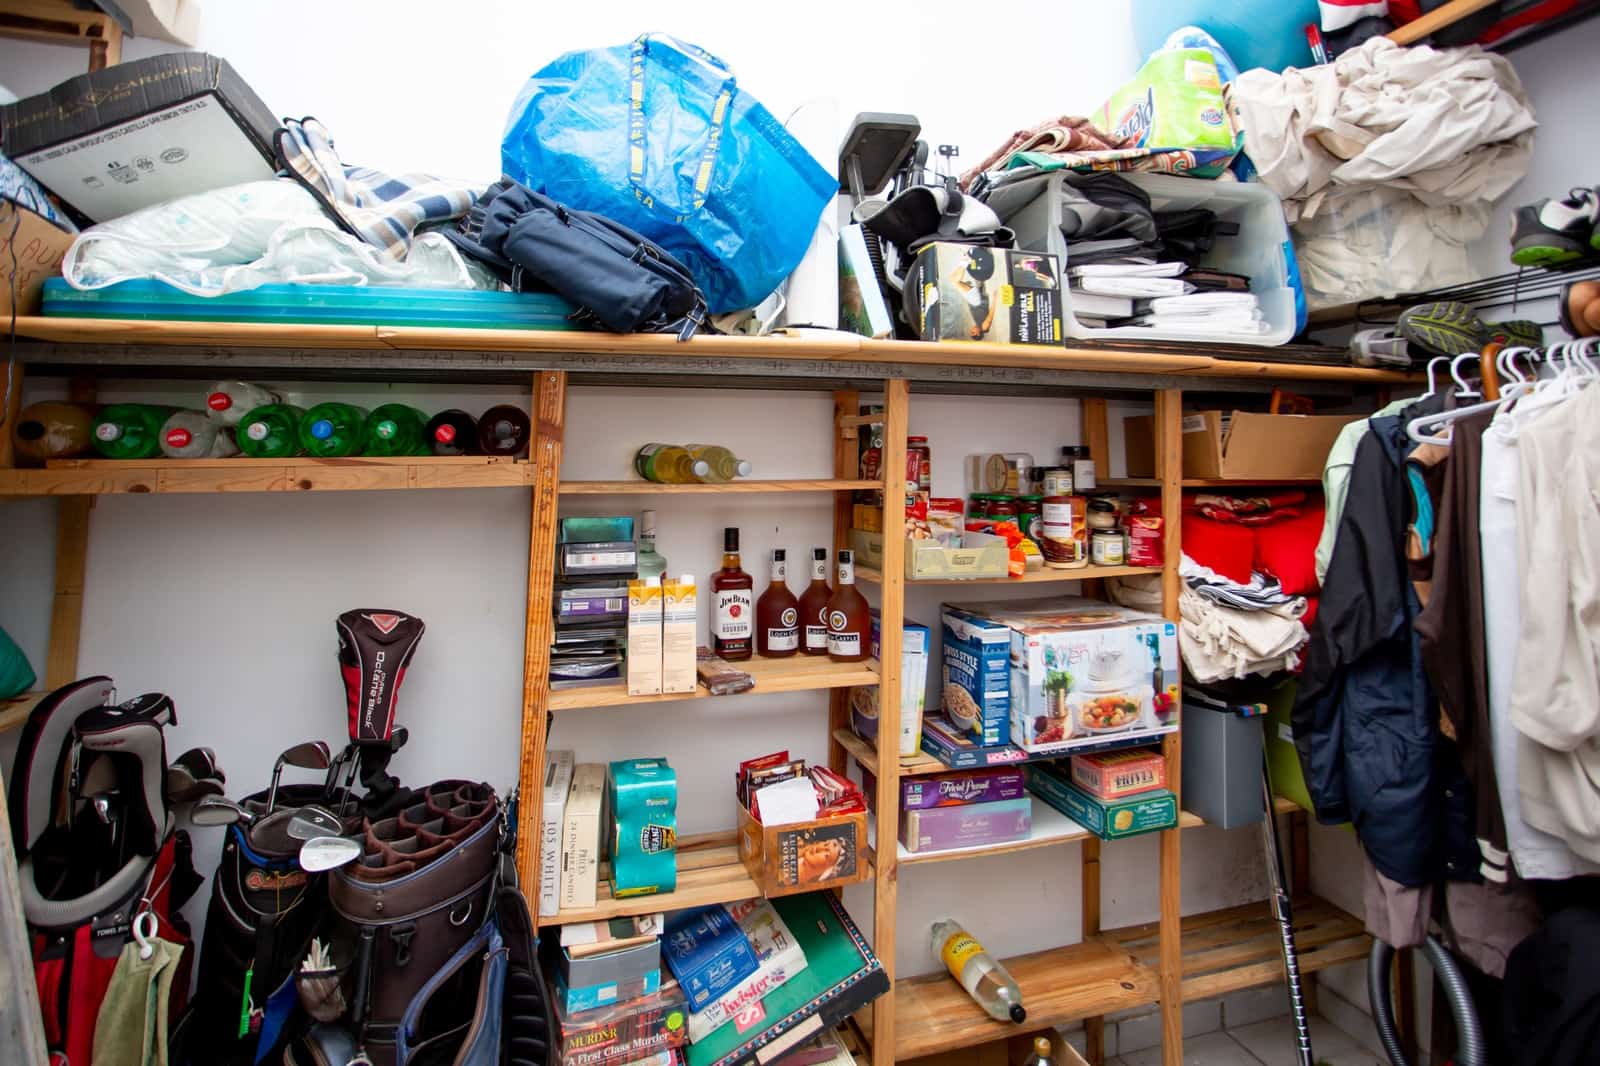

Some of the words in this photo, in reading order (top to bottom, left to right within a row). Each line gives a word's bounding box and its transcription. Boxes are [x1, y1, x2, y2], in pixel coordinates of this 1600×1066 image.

[720, 597, 732, 608] JIM
[369, 650, 386, 697] Octane
[364, 698, 377, 729] Black
[547, 820, 557, 844] 105
[568, 833, 577, 866] DINNER
[543, 850, 556, 900] WHITE
[721, 974, 770, 1018] Twister
[577, 1050, 602, 1064] First
[603, 1045, 630, 1058] Class
[632, 1032, 669, 1049] Murder
